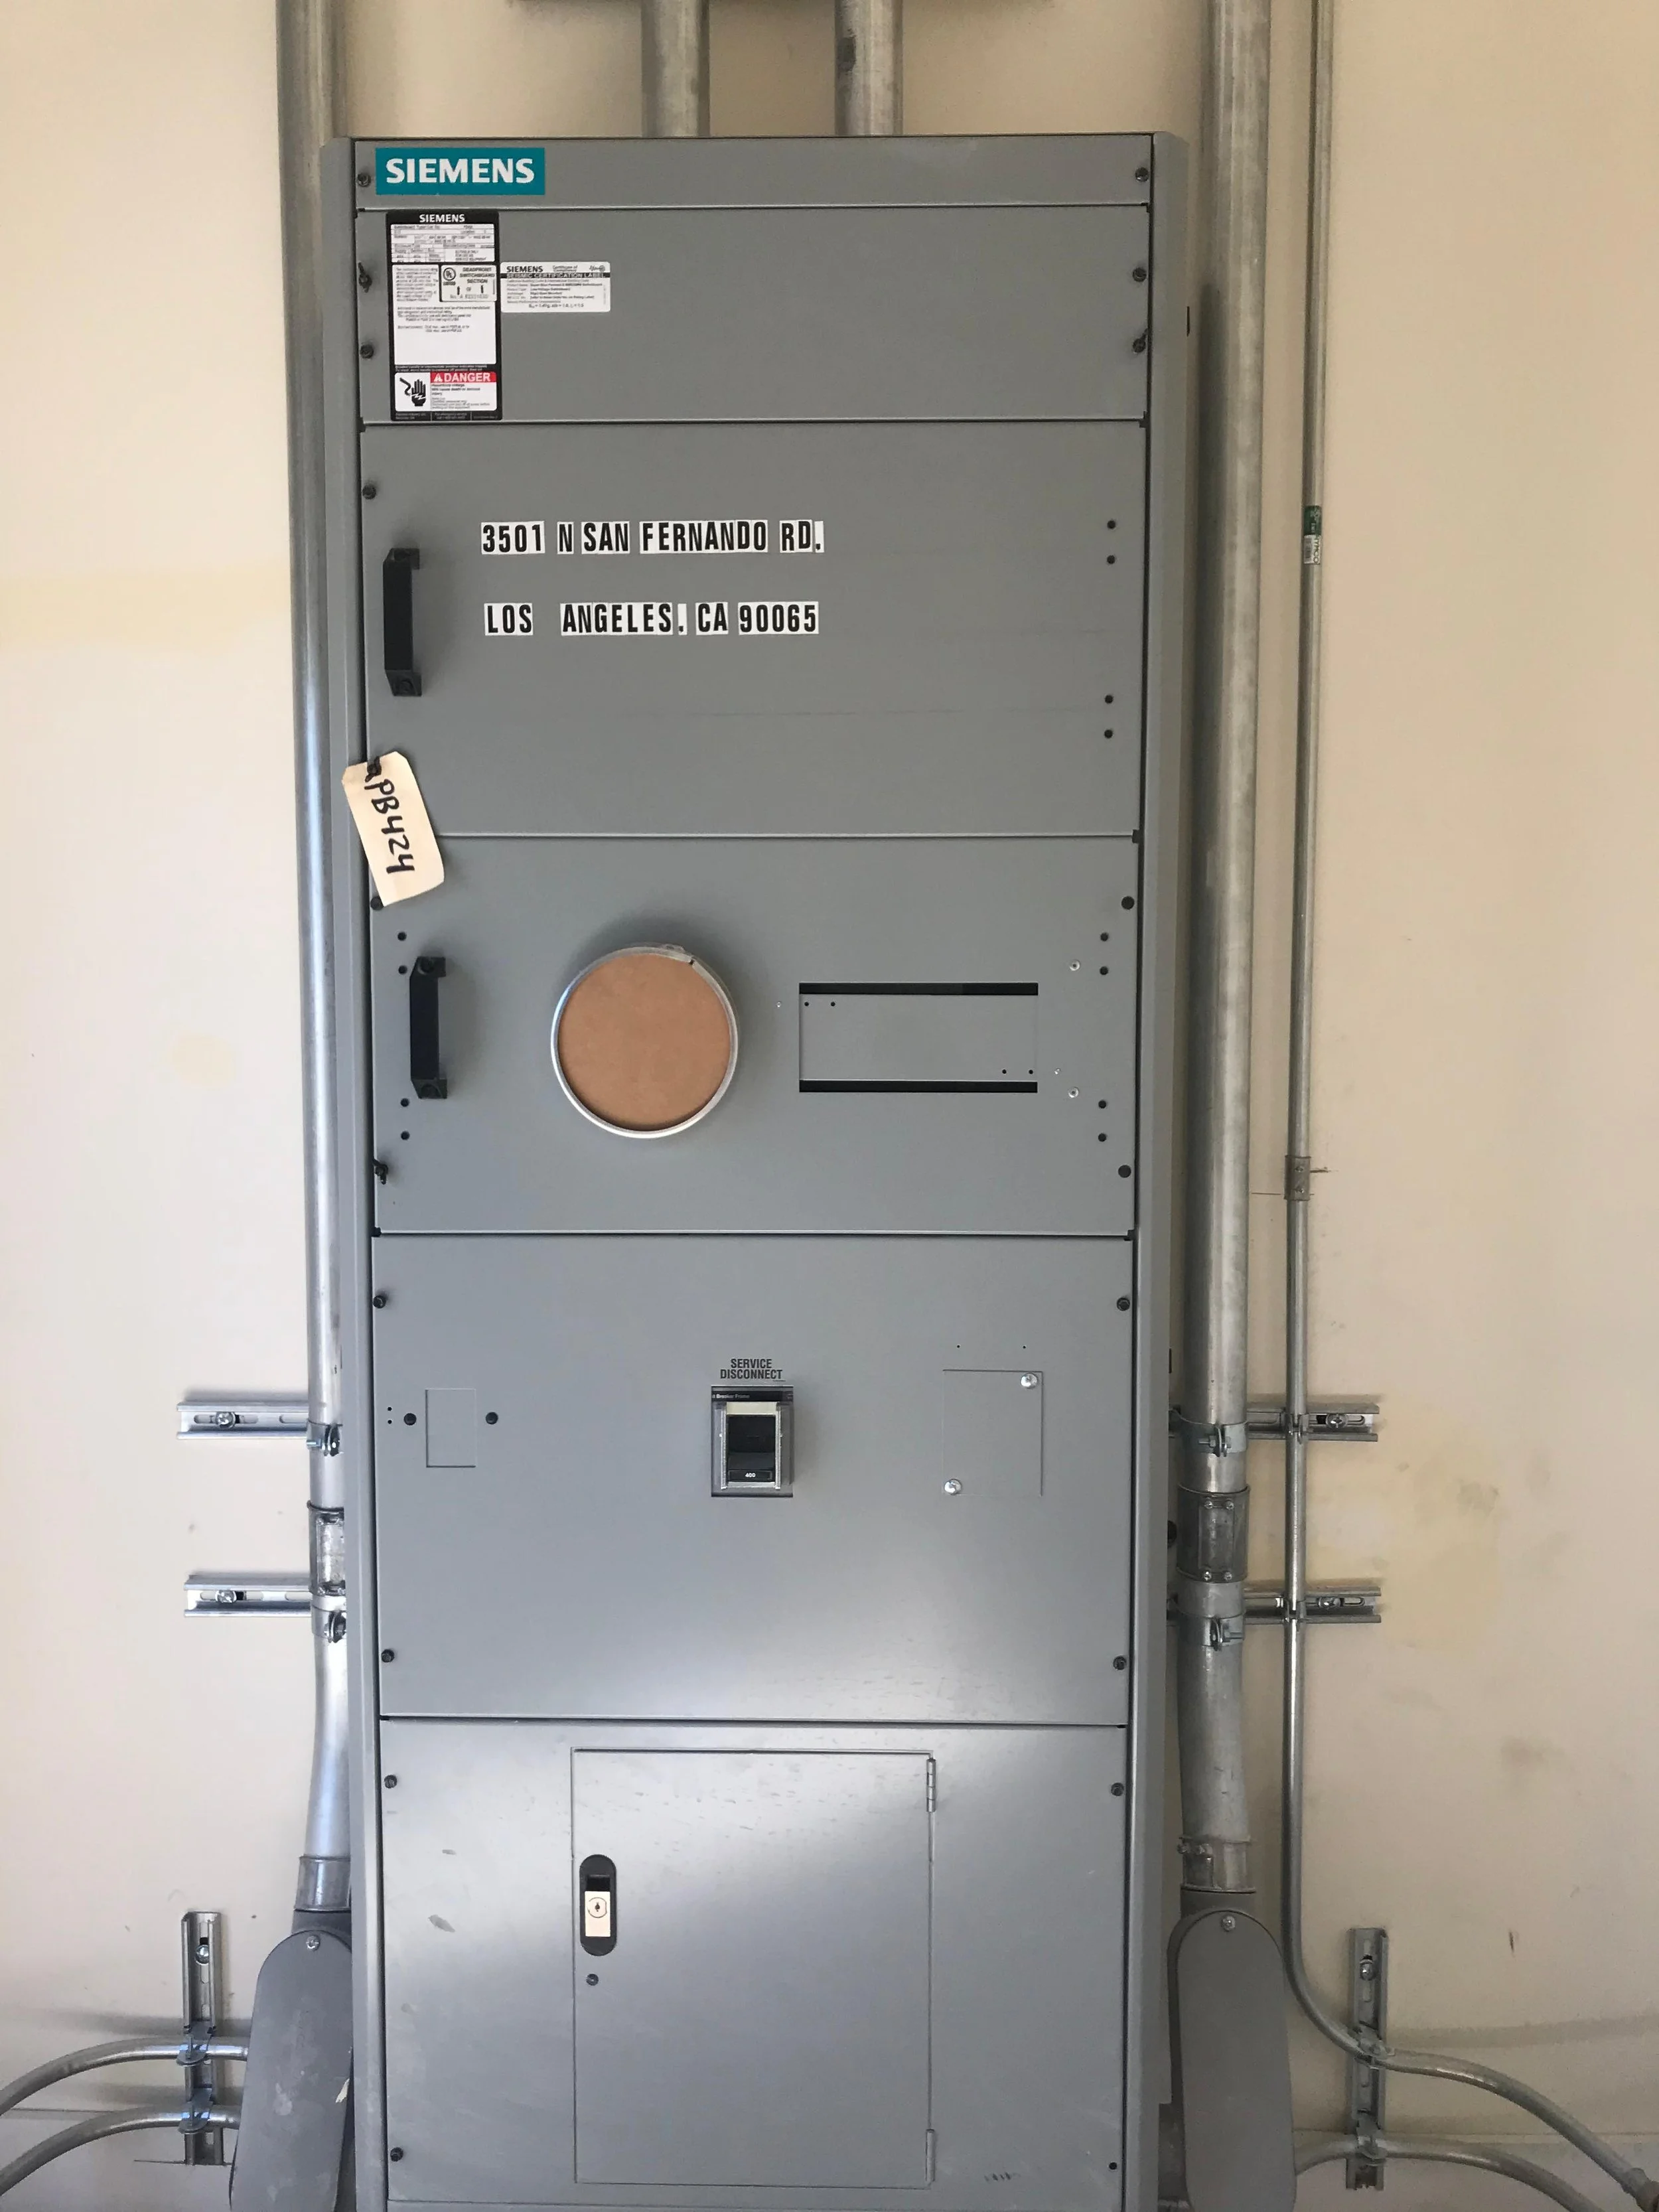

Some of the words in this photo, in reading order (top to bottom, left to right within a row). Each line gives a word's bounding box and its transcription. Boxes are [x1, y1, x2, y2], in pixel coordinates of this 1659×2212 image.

[386, 158, 535, 184] SIEMENS
[419, 214, 465, 223] SIEMENS
[444, 372, 491, 382] DANGER
[482, 524, 541, 552] 3501
[559, 524, 573, 552] N
[583, 522, 629, 552] SAN
[642, 521, 766, 552] FERNANDO
[487, 604, 532, 633] LOS
[697, 603, 728, 632] CA
[739, 604, 816, 632] 90065
[730, 1359, 772, 1368] SERVICE
[720, 1369, 783, 1380] DISCONNECT
